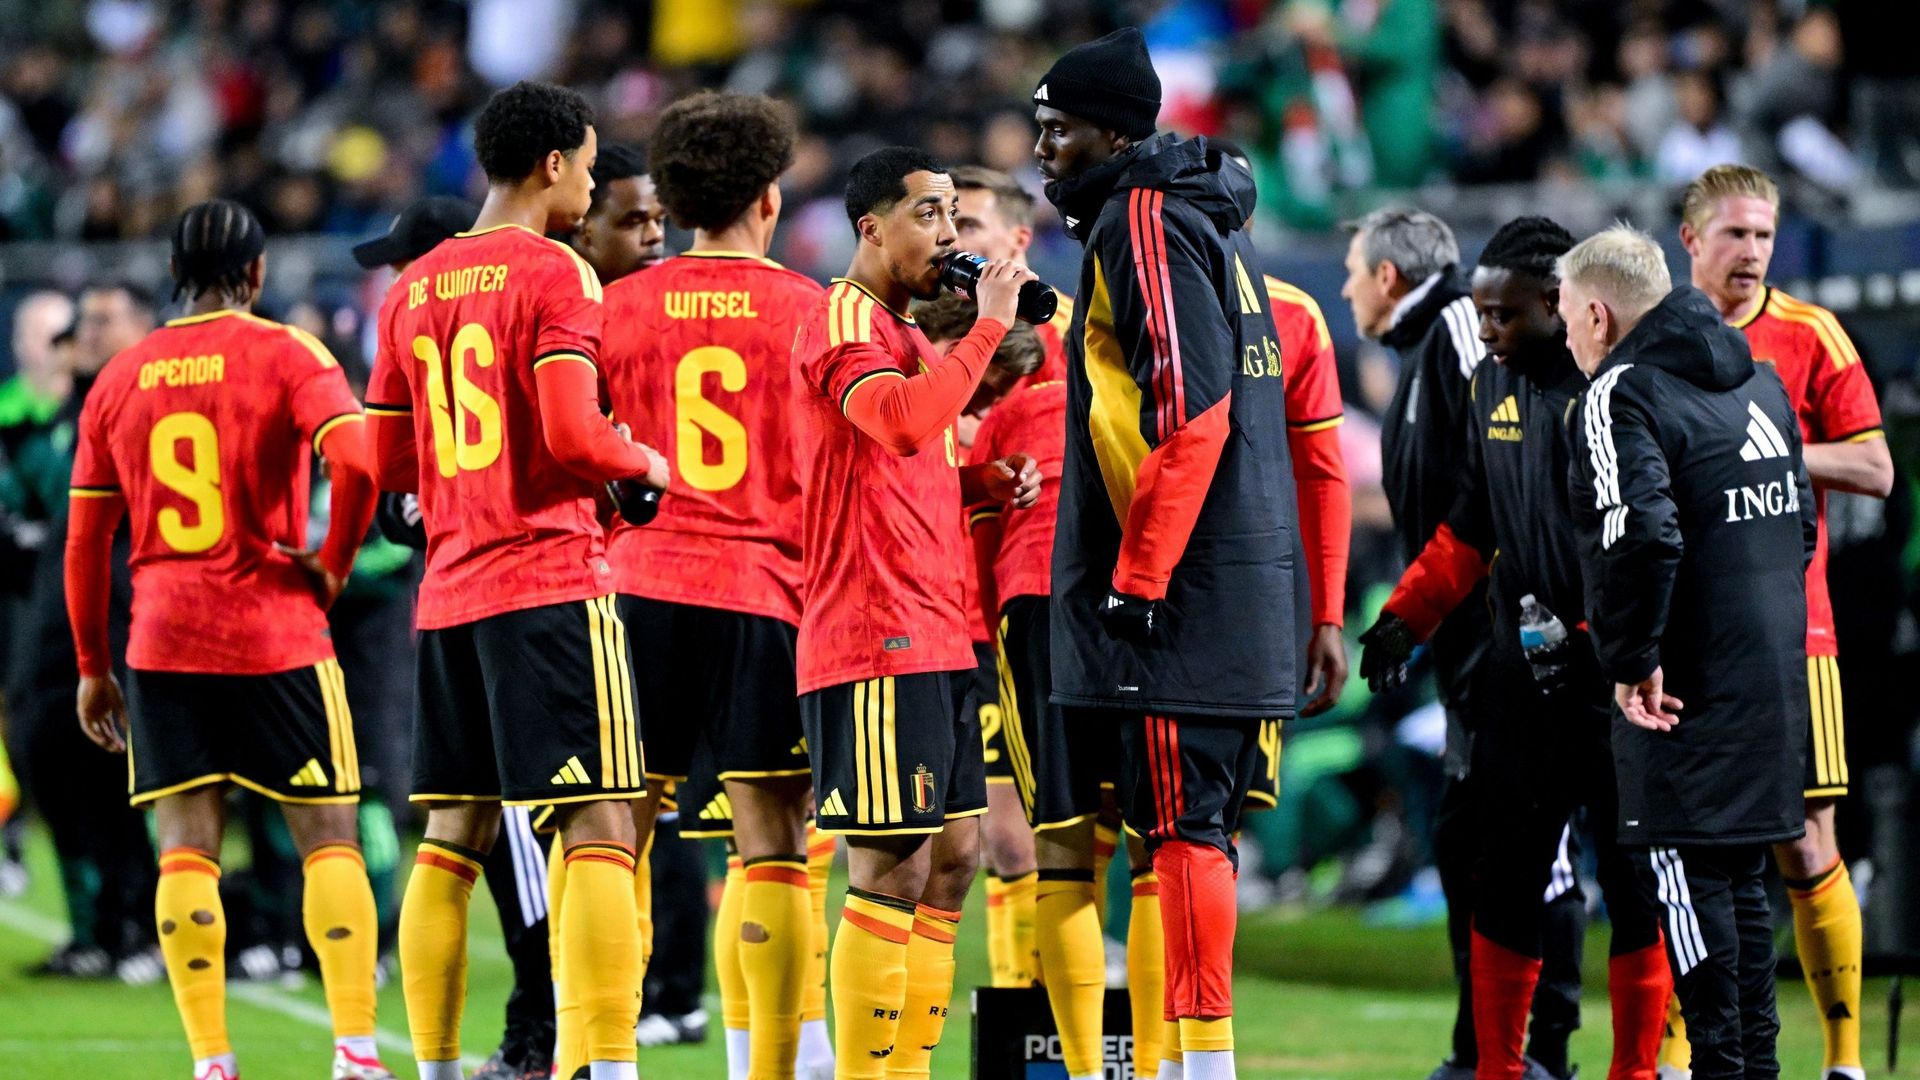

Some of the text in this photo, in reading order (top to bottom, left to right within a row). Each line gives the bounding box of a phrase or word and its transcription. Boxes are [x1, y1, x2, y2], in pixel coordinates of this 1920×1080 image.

[408, 264, 509, 311] DE WINTER
[664, 290, 758, 320] WITSEL
[139, 353, 225, 390] OPENDA
[412, 322, 502, 478] 16
[675, 346, 748, 491] 6
[150, 412, 224, 553] 9
[1723, 480, 1784, 523] ING
[1024, 1034, 1134, 1061] POER
